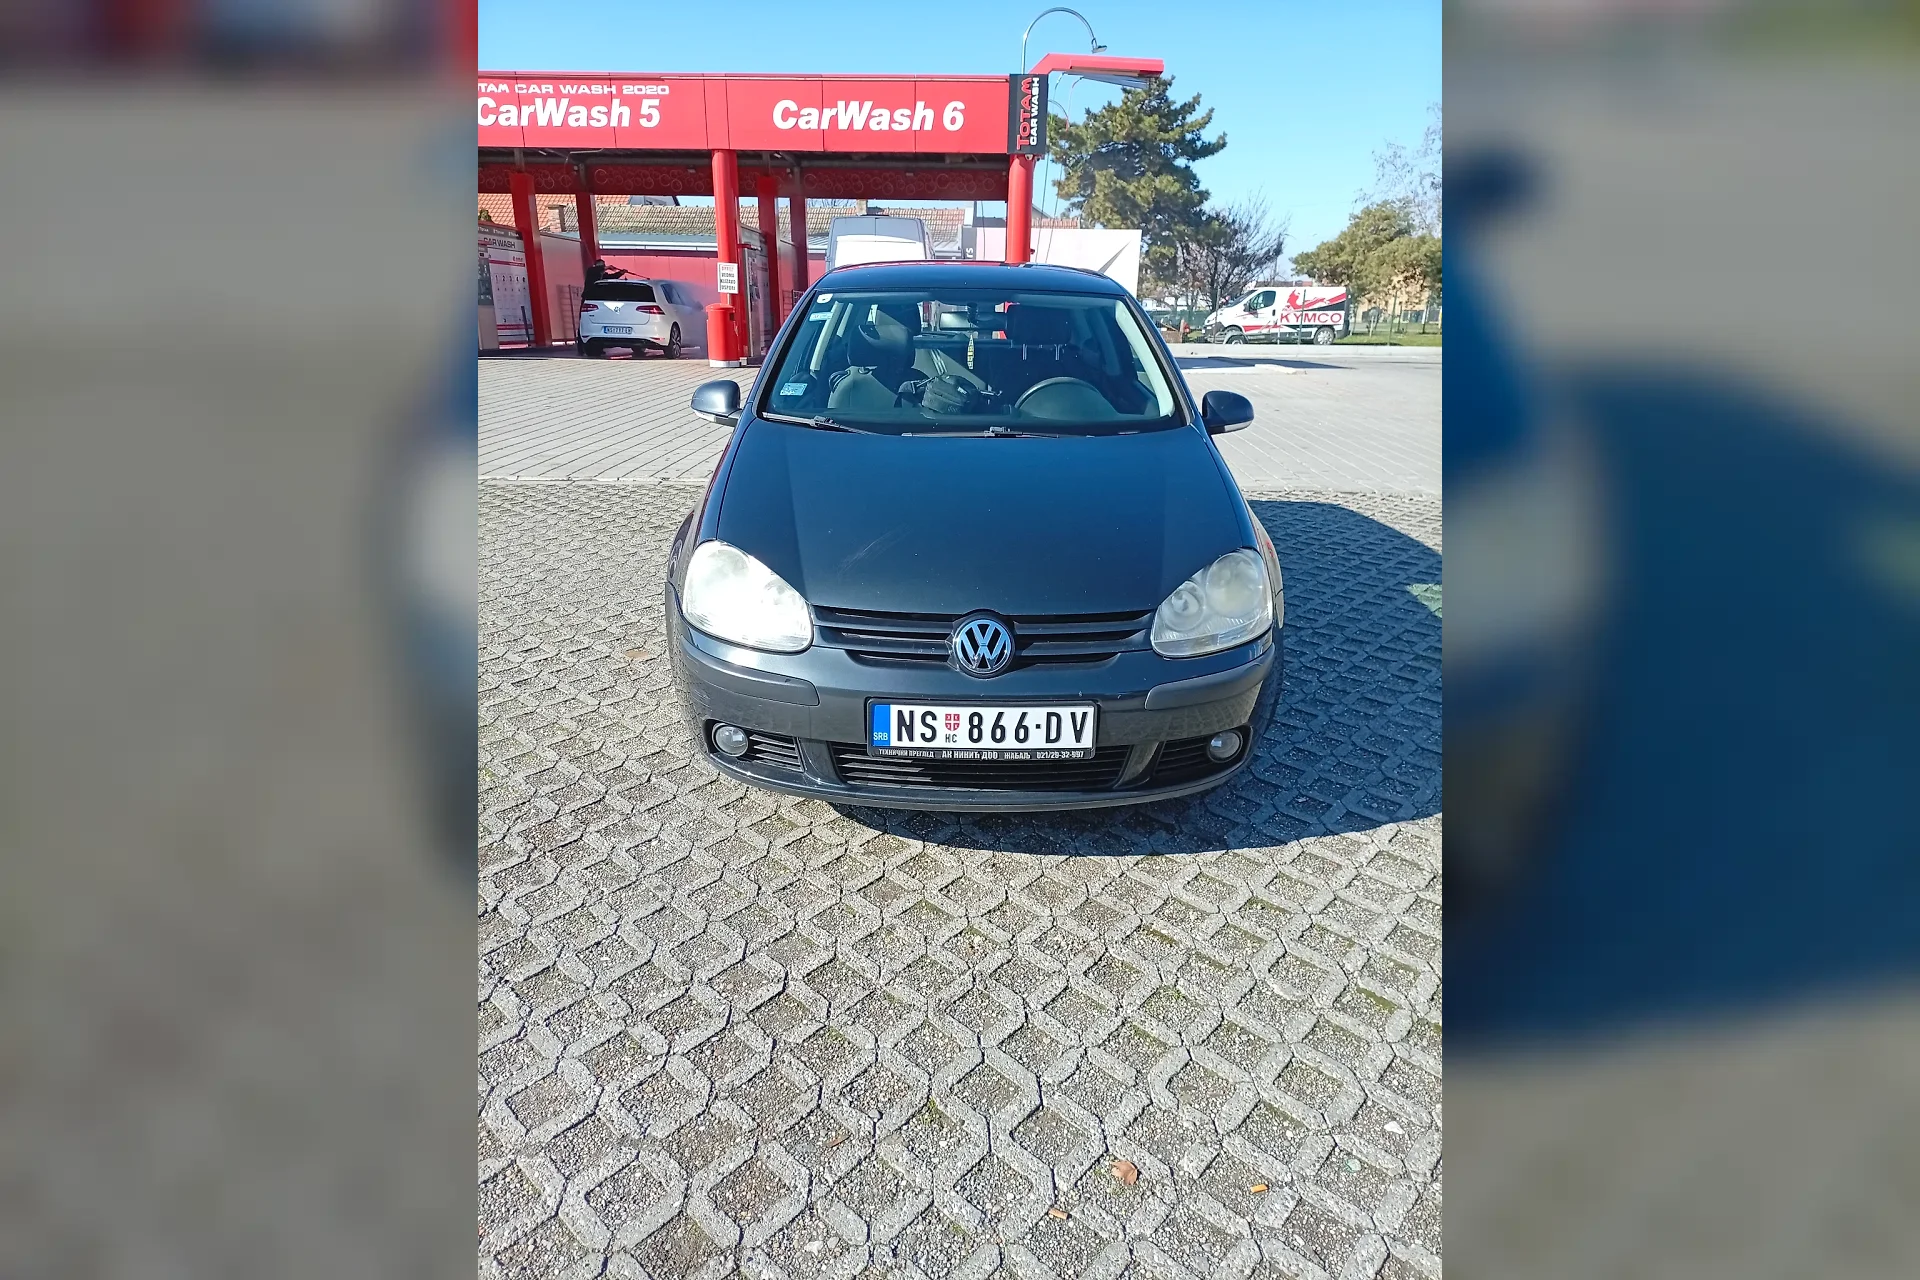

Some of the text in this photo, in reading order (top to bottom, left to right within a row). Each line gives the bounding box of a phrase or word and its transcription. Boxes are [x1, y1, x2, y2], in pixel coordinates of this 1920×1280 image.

[478, 83, 670, 95] TAM CAR WASH 2020
[478, 96, 661, 128] CarWash 5
[772, 99, 966, 131] CarWash 6
[1017, 77, 1032, 150] TOTAM
[1030, 77, 1040, 146] CAR WASH
[1280, 312, 1342, 323] KYMCO
[873, 731, 889, 741] SRB
[897, 709, 937, 743] NS
